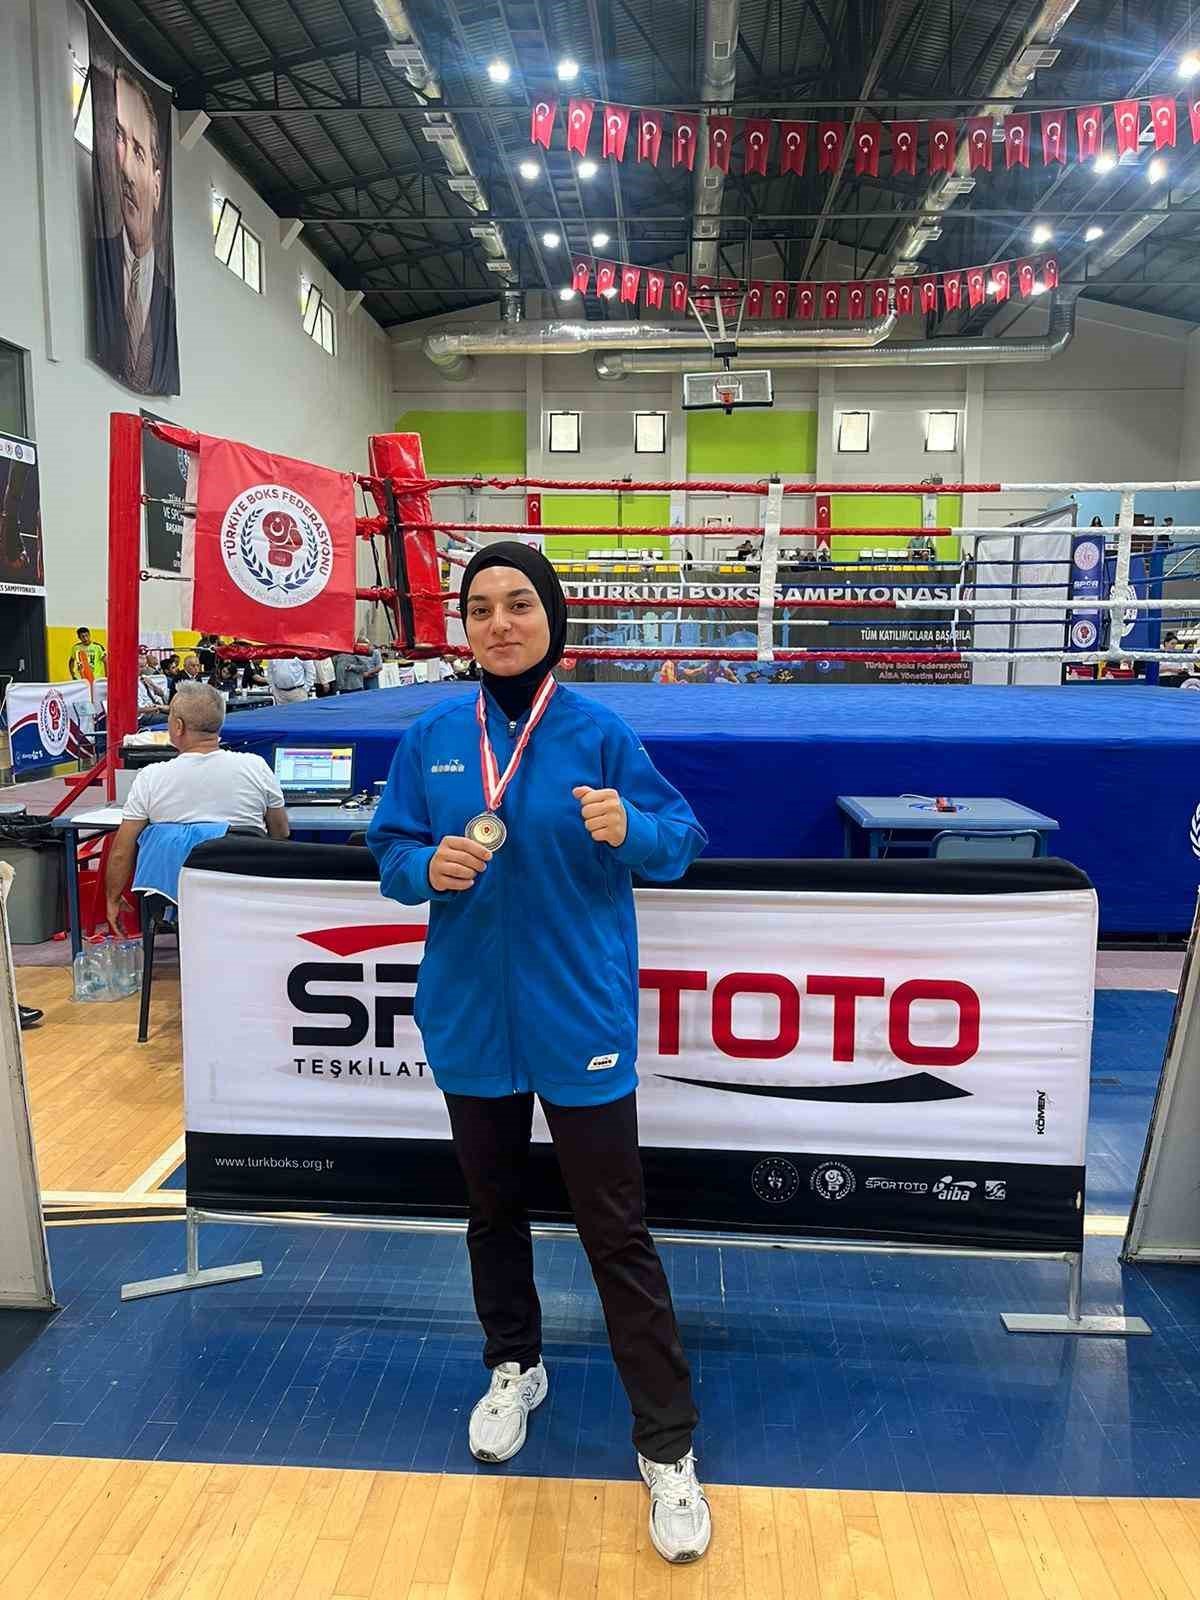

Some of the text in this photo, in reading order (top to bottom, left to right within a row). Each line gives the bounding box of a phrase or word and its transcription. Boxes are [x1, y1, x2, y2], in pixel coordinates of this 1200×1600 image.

[224, 489, 331, 576] TÜRKİYE BOKS FEDERASYONU
[689, 586, 760, 600] BOKS
[861, 627, 878, 641] TÜM
[879, 629, 934, 641] KATILIMCILARA
[293, 1057, 427, 1078] TEŞKİLAT
[215, 1156, 335, 1171] www.turkboks.org.tr
[938, 1186, 970, 1200] aiba
